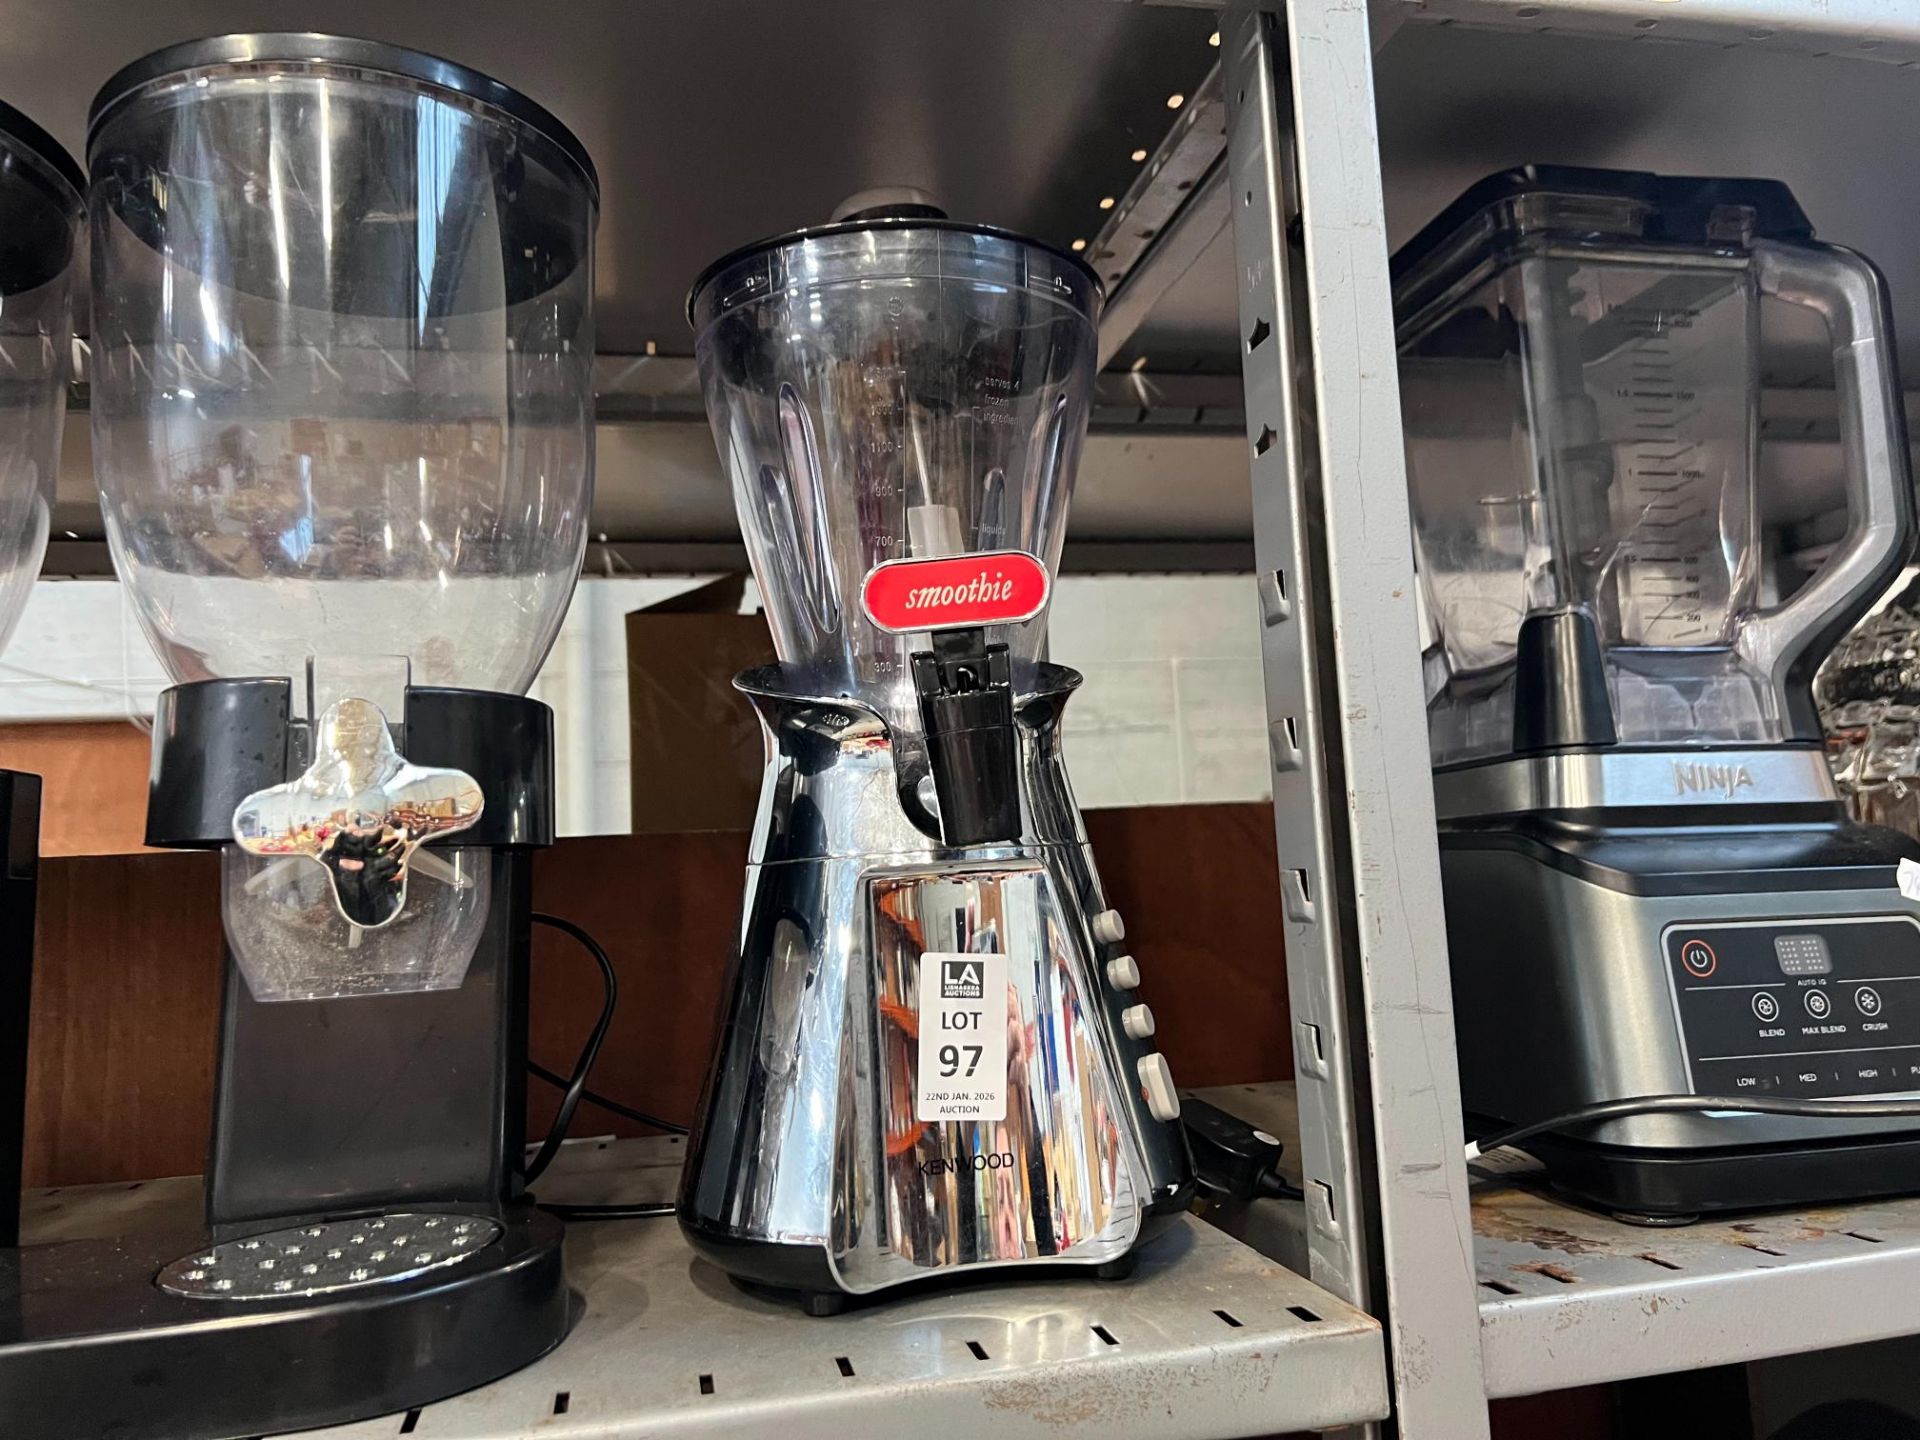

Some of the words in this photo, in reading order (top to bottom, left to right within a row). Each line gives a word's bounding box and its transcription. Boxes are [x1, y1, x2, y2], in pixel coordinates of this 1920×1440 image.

[875, 535, 894, 547] 700
[905, 571, 1012, 609] smoothie
[874, 662, 891, 673] 300
[1671, 761, 1755, 800] NINJA
[944, 963, 981, 985] LA
[941, 1011, 982, 1030] LOT
[1801, 1026, 1820, 1035] MAX
[1820, 1024, 1847, 1034] BLEND
[1861, 1022, 1889, 1032] CRUSH
[1758, 1028, 1786, 1038] BLEND
[938, 1045, 984, 1078] 97
[1799, 1073, 1818, 1083] MED
[1858, 1068, 1878, 1078] HIGH
[1736, 1077, 1757, 1087] LOW
[925, 1091, 950, 1101] 22ND
[951, 1091, 972, 1102] JAN.
[974, 1091, 995, 1101] 2026
[939, 1104, 980, 1115] AUCTION
[917, 1151, 1015, 1177] KENWOOD
